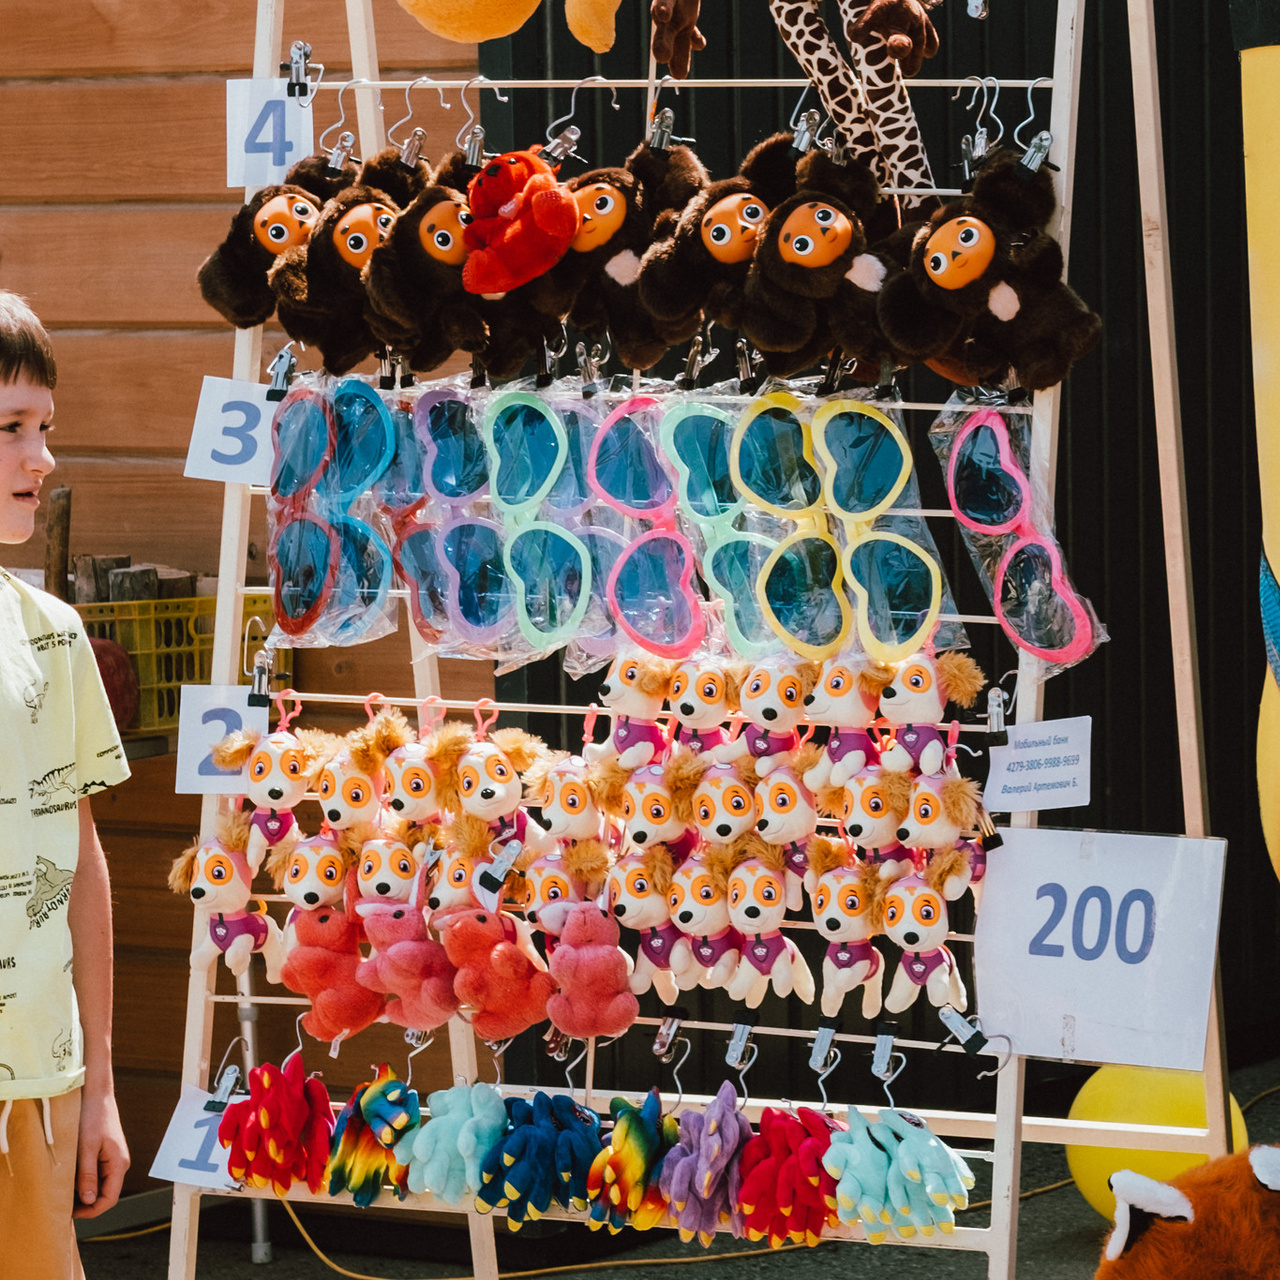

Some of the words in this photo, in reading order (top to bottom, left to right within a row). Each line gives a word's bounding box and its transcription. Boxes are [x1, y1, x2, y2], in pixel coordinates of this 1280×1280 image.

[244, 99, 294, 167] 4
[210, 400, 263, 466] 3
[197, 706, 243, 776] 2
[1013, 735, 1053, 750] Мобильный
[1053, 734, 1070, 746] банк
[1028, 882, 1156, 965] 200
[178, 1113, 223, 1173] 1
